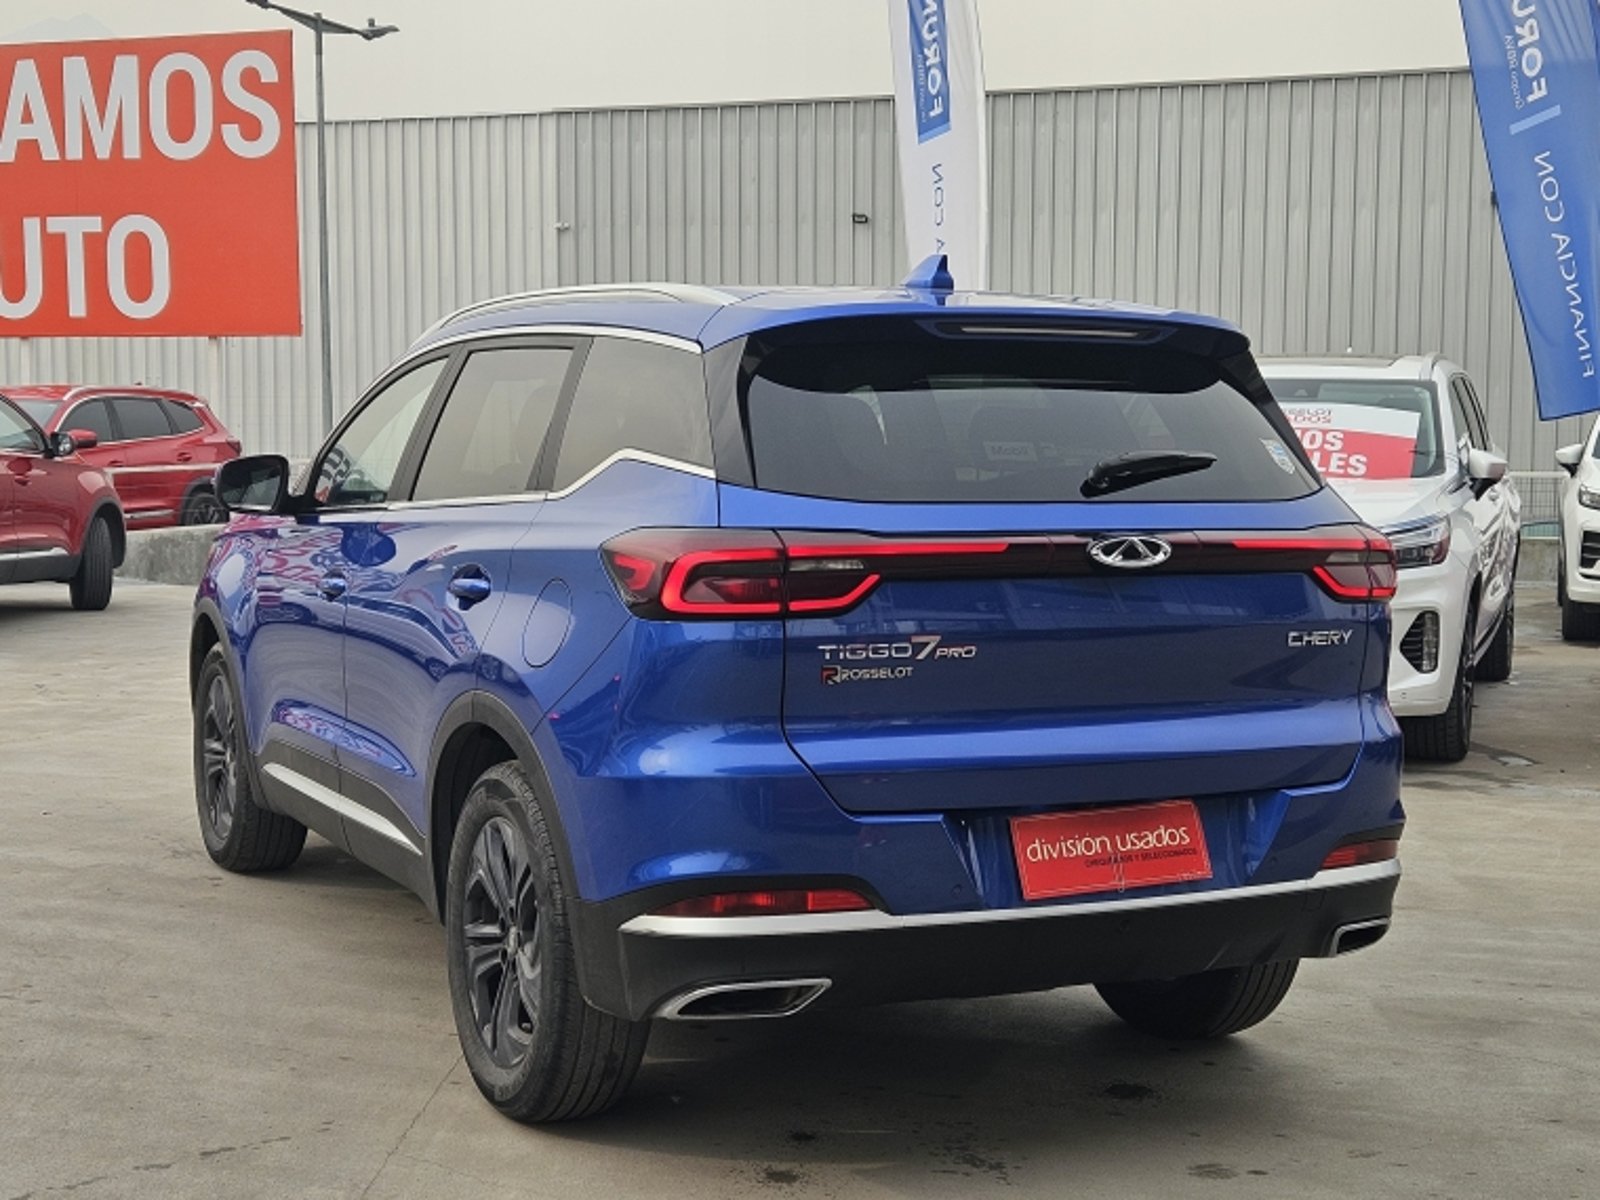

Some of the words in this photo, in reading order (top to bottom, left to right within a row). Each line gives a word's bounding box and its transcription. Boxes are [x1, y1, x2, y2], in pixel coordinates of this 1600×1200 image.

[0, 50, 281, 163] AMOS
[0, 214, 171, 319] UTO
[1296, 429, 1344, 451] OS
[1287, 629, 1353, 647] CHERY
[1026, 832, 1111, 862] división
[1115, 825, 1190, 851] usados
